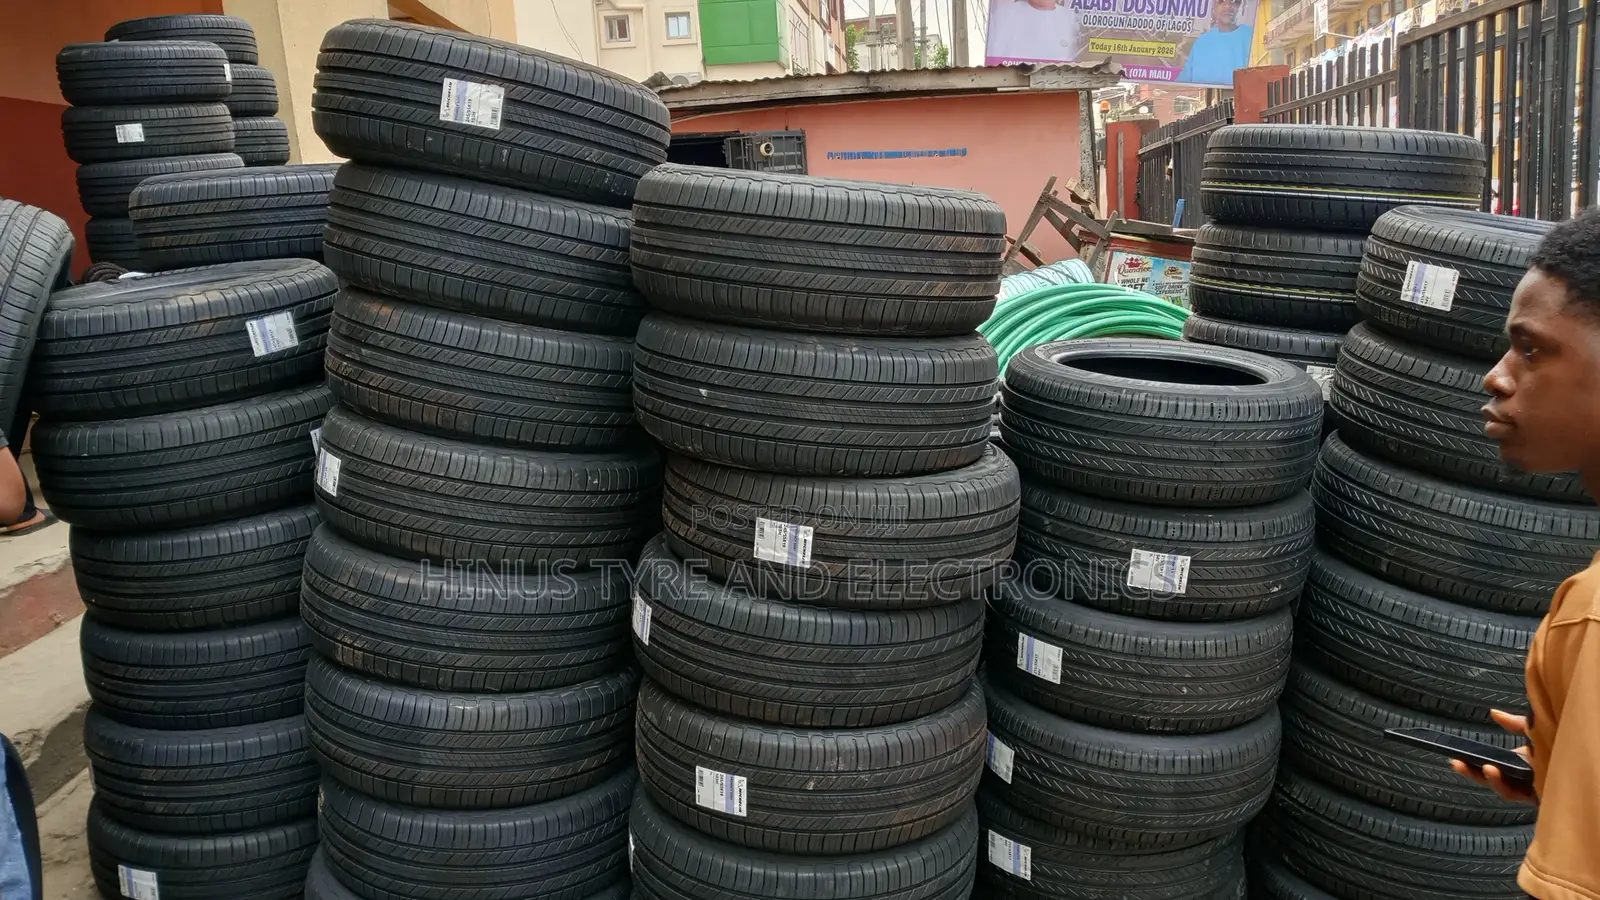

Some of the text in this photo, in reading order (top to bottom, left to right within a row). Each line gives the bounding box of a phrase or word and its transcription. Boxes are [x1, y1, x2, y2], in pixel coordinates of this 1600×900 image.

[1070, 0, 1209, 18] ALABI DOSUNMU
[1082, 14, 1192, 32] OLOROGUN ADODO OF LAGOS
[1091, 42, 1112, 53] Today
[1129, 45, 1157, 55] January
[1157, 46, 1174, 55] 2026
[1129, 68, 1147, 78] (OTA
[1149, 69, 1172, 80] MALI)
